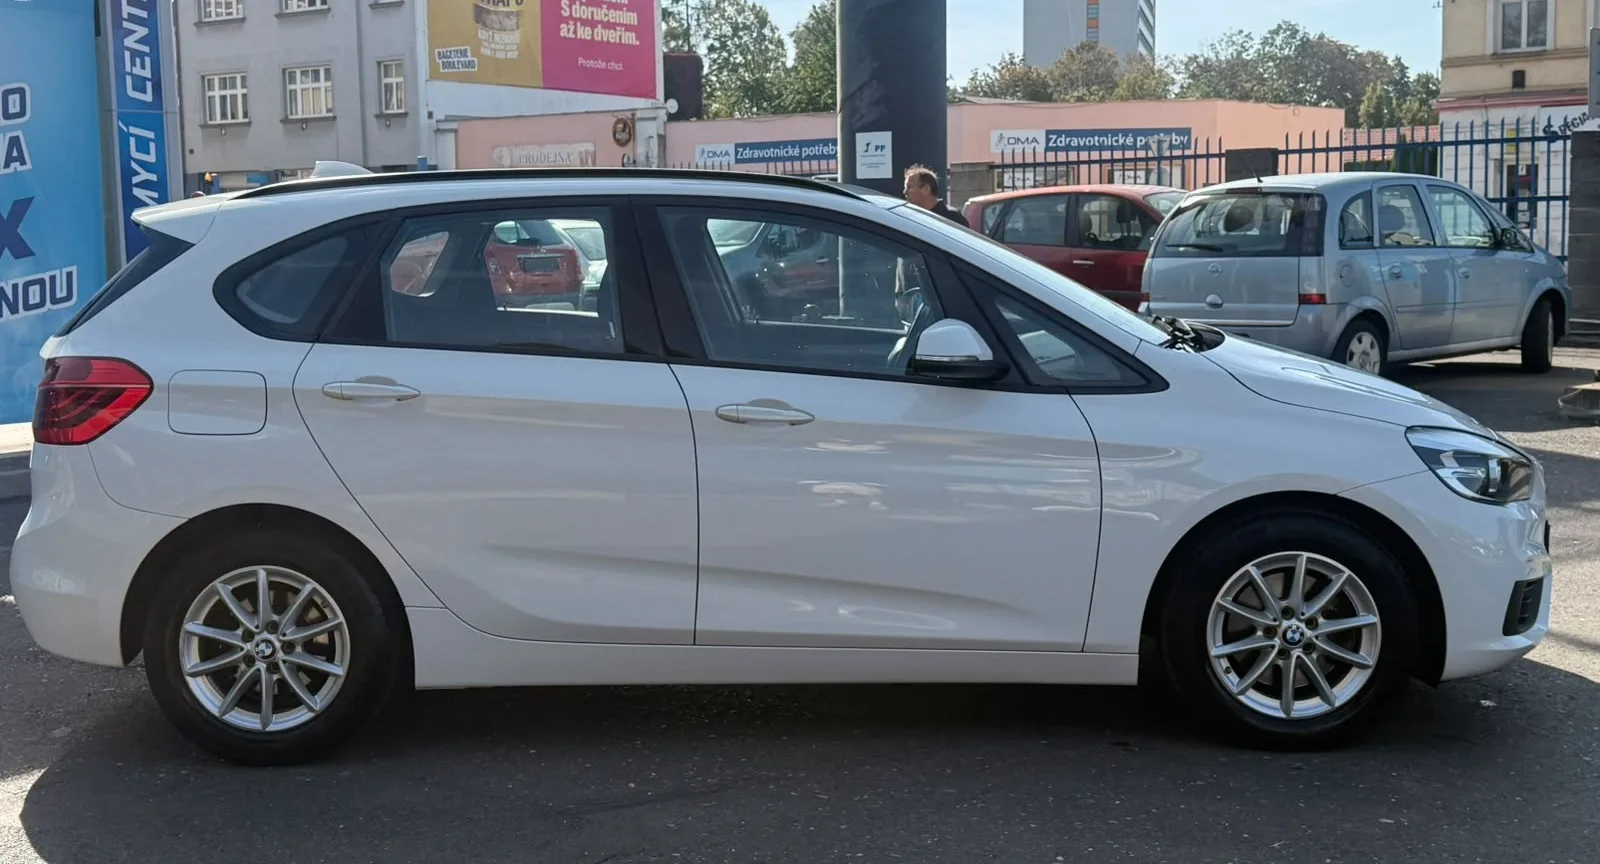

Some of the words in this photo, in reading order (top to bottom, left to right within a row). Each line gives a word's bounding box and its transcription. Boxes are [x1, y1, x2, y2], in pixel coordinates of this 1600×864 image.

[561, 0, 570, 17] S
[560, 20, 576, 38] až
[577, 21, 592, 40] ke
[121, 0, 153, 102] CENT
[441, 59, 476, 70] BOULEVARD
[577, 56, 606, 70] Protože
[1007, 136, 1039, 146] DMA
[1048, 133, 1134, 147] Zdravotnické
[707, 150, 732, 160] DMA
[736, 144, 800, 159] Zdravotnické
[802, 141, 838, 158] potřeb
[518, 152, 573, 165] PRODEJNA
